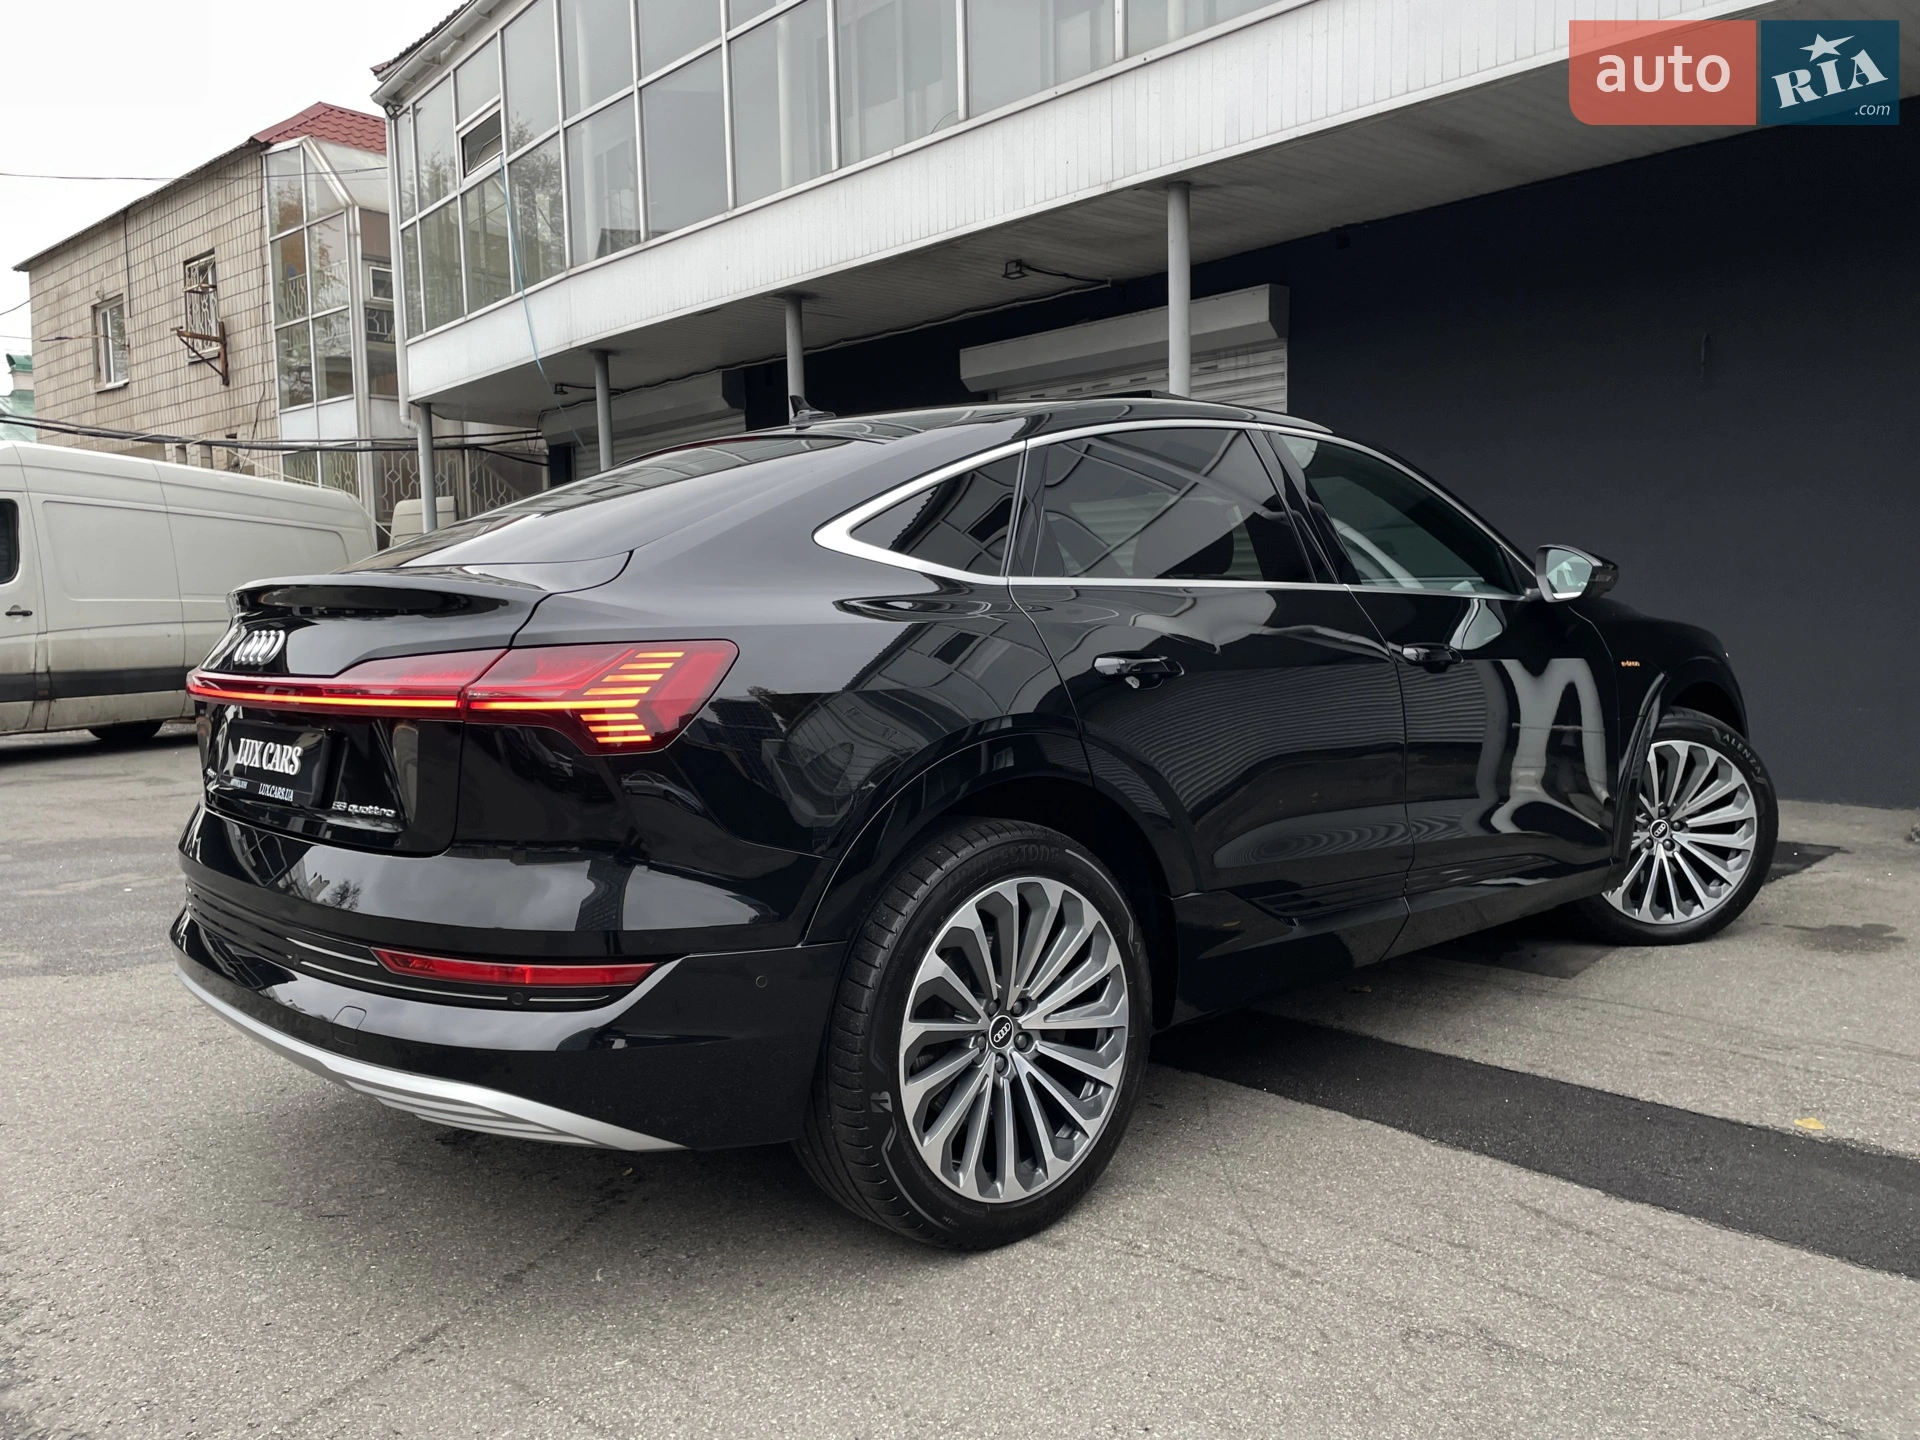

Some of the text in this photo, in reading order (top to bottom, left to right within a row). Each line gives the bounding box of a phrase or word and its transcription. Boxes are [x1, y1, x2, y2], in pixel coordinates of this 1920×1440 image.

[236, 737, 303, 775] LUX CARS
[1722, 733, 1761, 774] ALENZA
[348, 804, 396, 818] quattro
[943, 843, 1060, 899] DGESTONE
